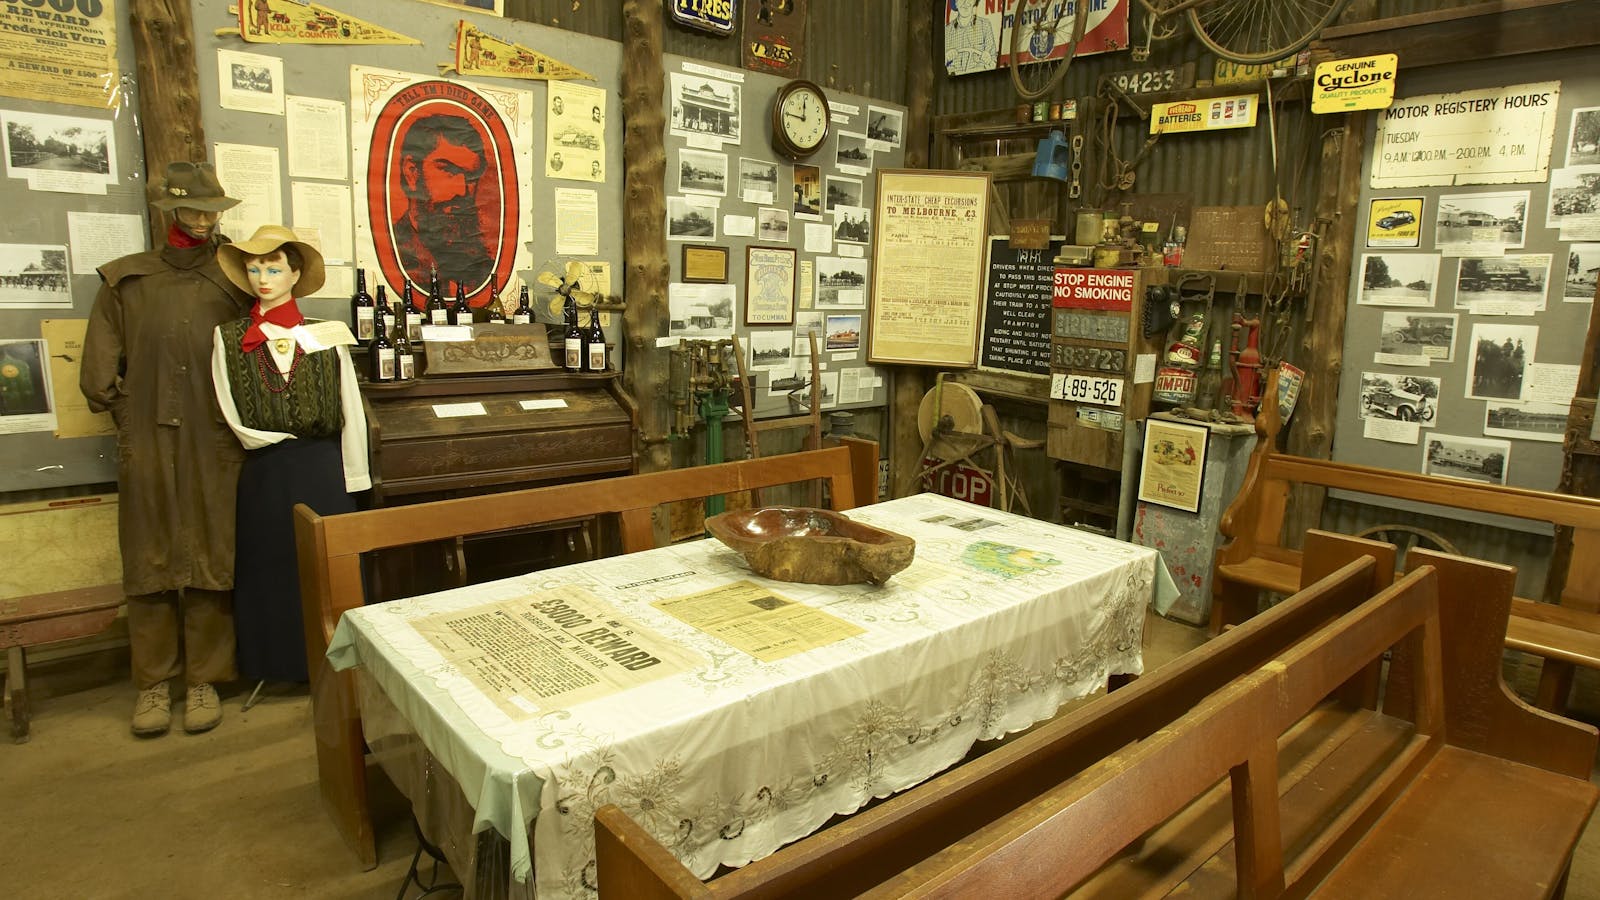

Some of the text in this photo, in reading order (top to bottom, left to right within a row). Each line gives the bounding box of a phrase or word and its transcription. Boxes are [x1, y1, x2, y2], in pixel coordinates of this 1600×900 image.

[7, 5, 89, 26] REWARD
[0, 21, 107, 46] rederick Vern
[270, 23, 296, 32] KELLY
[1335, 60, 1376, 72] GENUINE
[1318, 70, 1392, 91] Cyclone
[447, 86, 469, 100] DIED
[1350, 88, 1386, 96] PRODUCTS
[1386, 93, 1550, 121] MOTOR REGISTERY HOURS
[1159, 113, 1202, 124] BATTERIES
[1387, 131, 1421, 145] TUESDAY
[886, 206, 897, 214] TO
[1054, 273, 1133, 288] STOP ENGINE
[1054, 286, 1132, 301] NO SMOKING
[1003, 319, 1040, 328] FRAMPTON
[1005, 348, 1030, 356] SHUNTING
[520, 611, 556, 634] ROBBERY
[531, 598, 593, 630] £8000
[576, 627, 662, 672] REWARD
